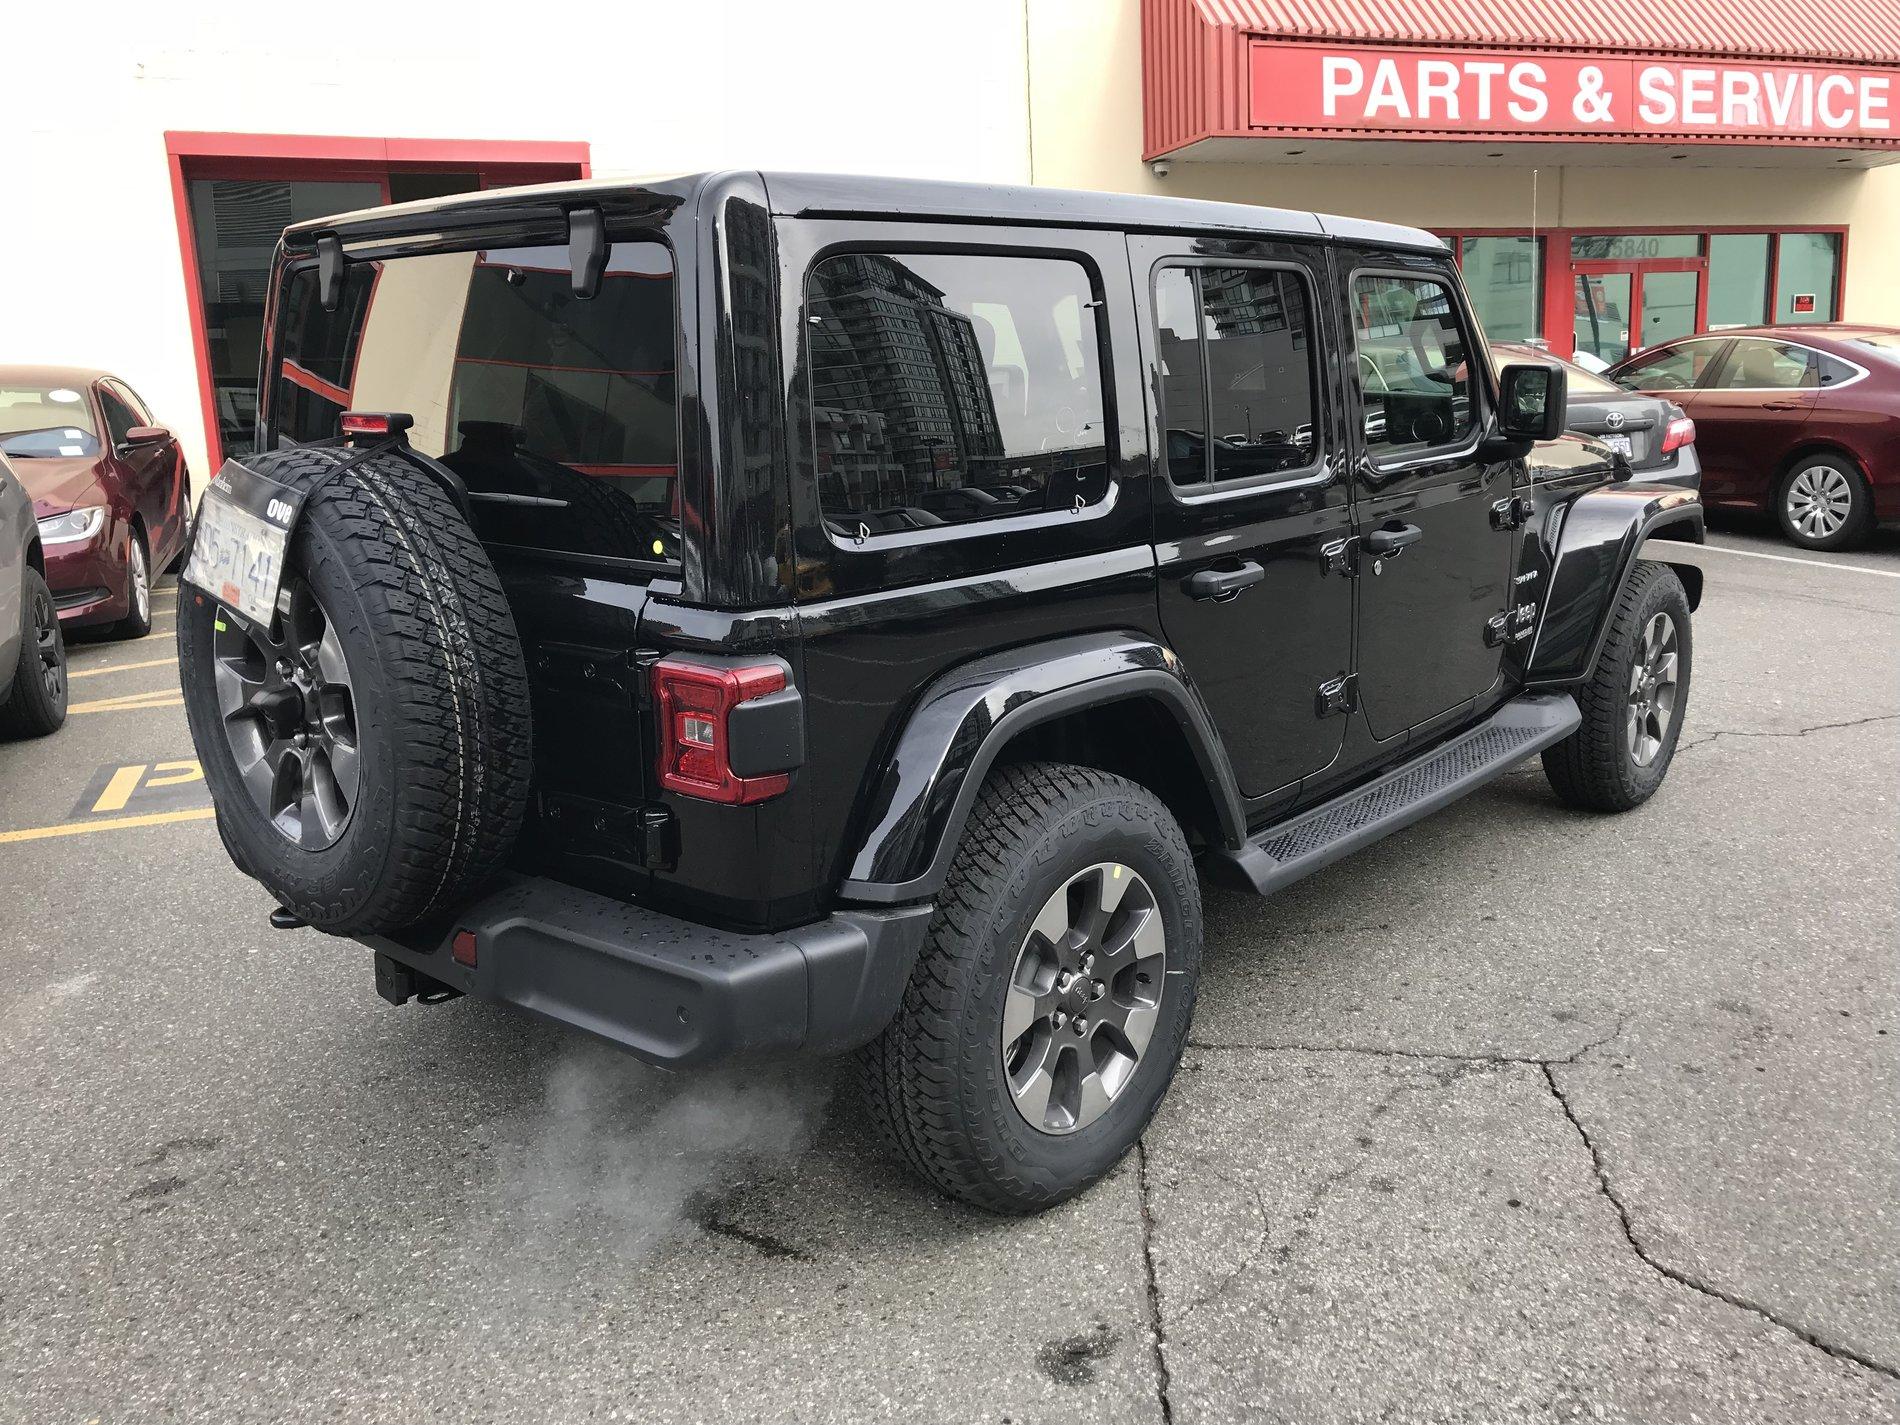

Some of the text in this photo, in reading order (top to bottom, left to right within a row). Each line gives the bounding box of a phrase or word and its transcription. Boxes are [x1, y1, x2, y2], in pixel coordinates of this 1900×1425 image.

[1322, 56, 1890, 129] PARTS & SERVICE
